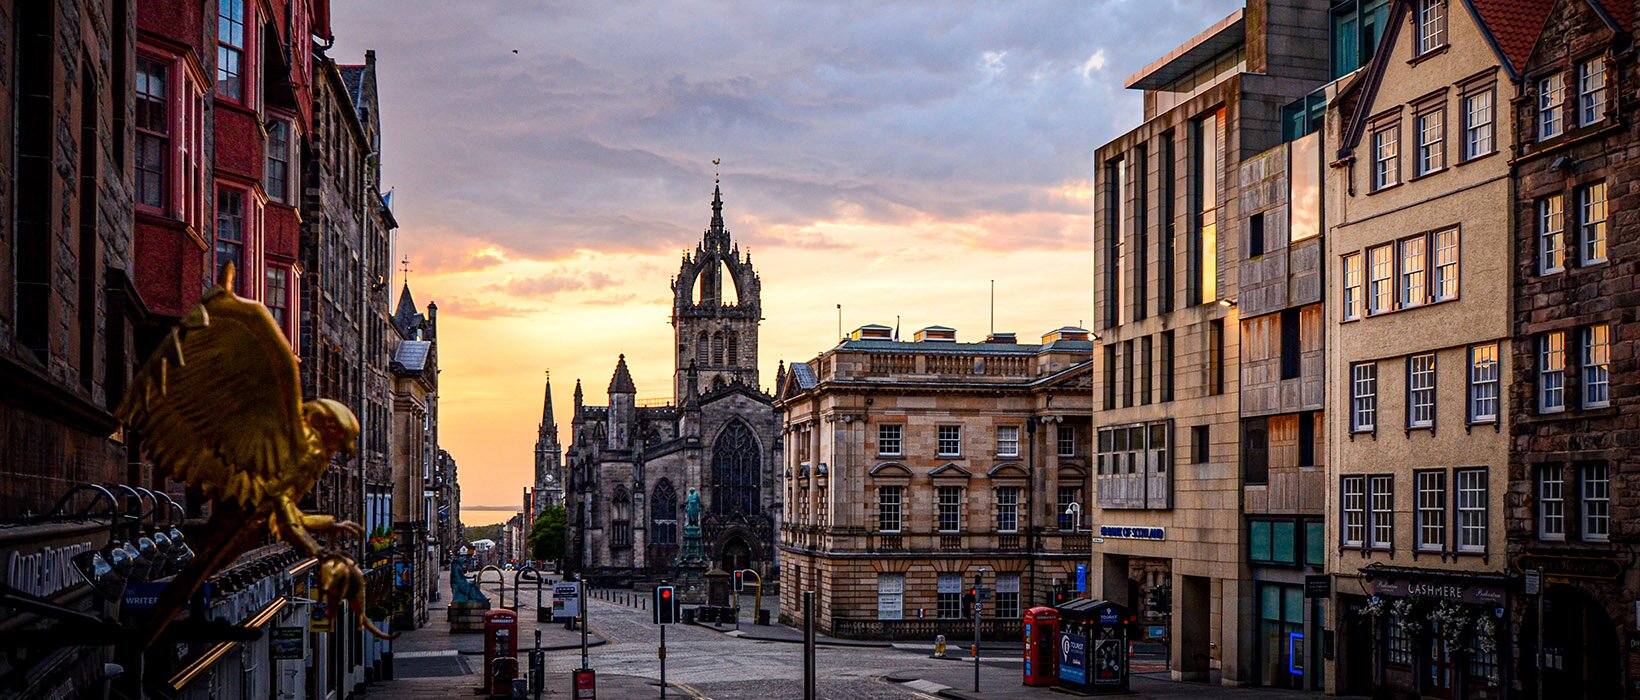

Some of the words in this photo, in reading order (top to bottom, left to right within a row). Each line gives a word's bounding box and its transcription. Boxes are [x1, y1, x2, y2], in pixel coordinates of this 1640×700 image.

[1132, 528, 1164, 540] SCOTLAND
[1407, 584, 1462, 598] CASHMERE
[1071, 641, 1084, 650] TOURIST
